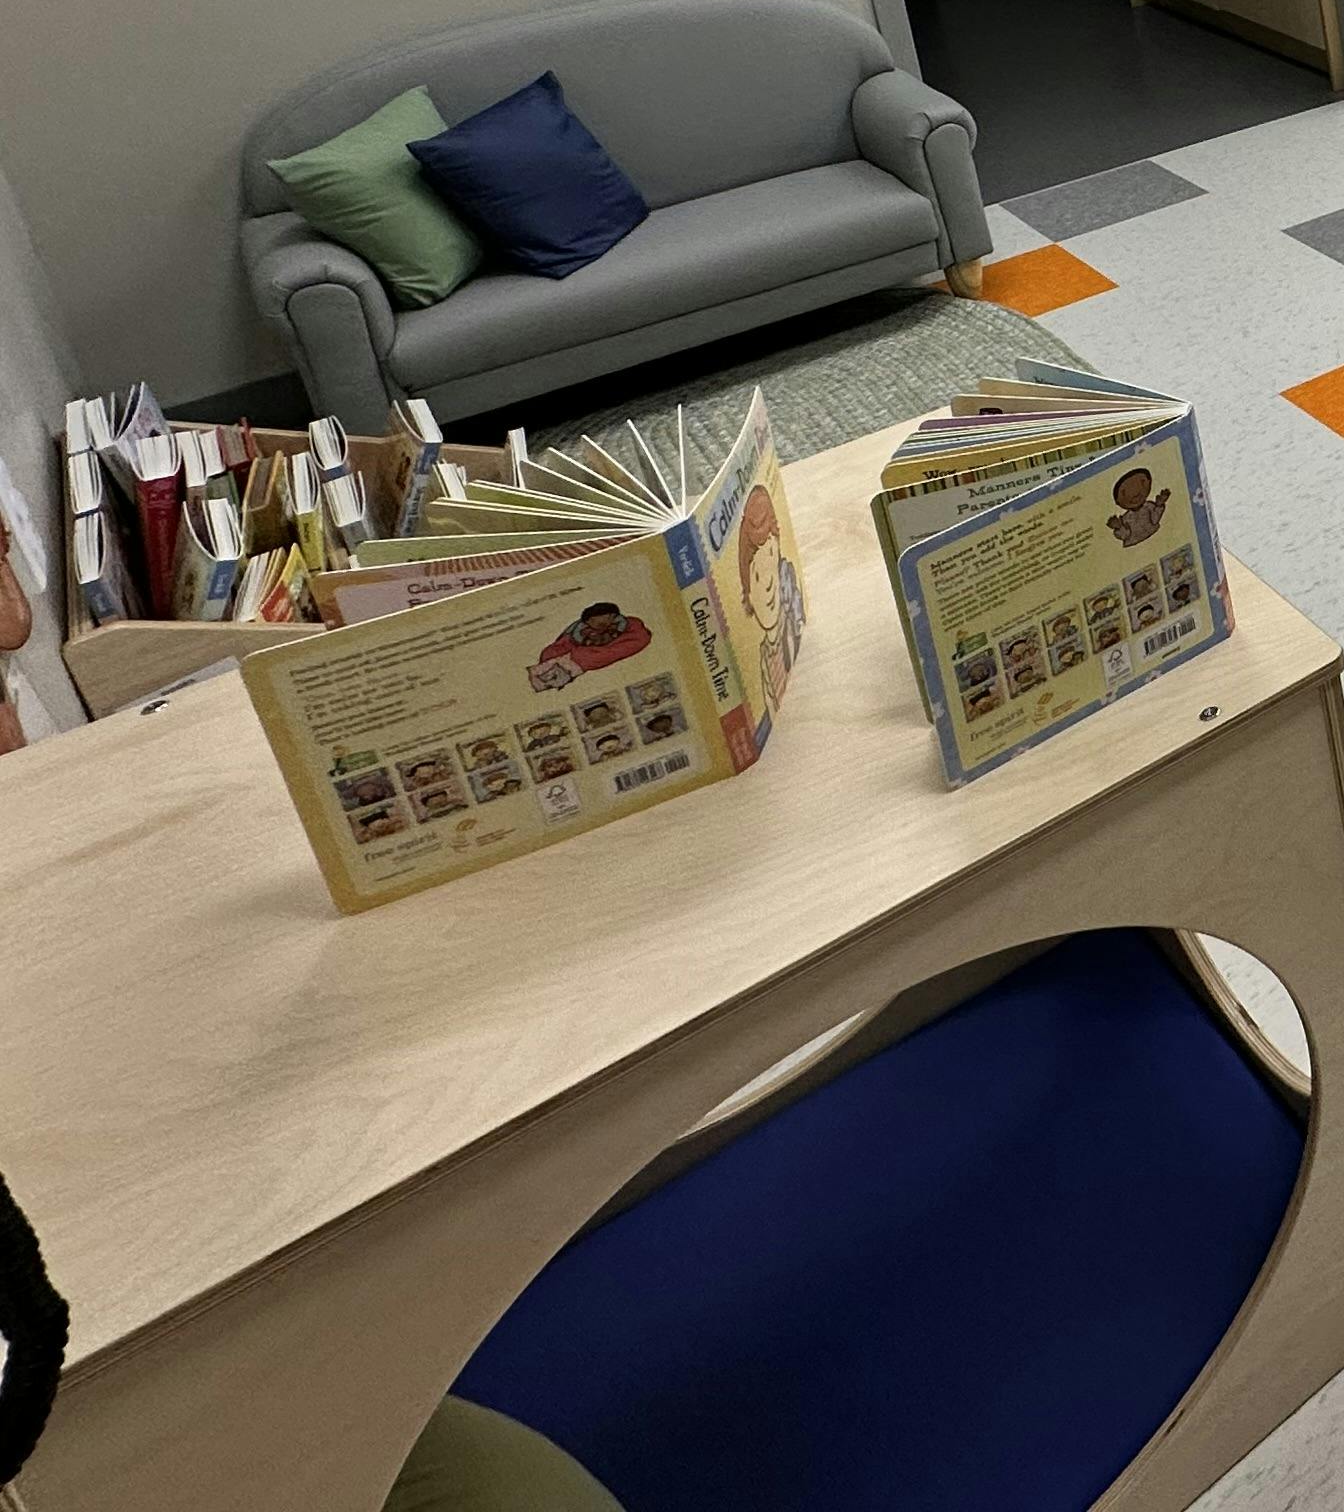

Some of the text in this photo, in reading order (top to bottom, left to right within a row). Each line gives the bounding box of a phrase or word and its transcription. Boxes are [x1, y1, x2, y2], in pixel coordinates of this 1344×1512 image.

[967, 474, 1041, 497] Manners
[690, 596, 730, 702] Calm-Down Time
